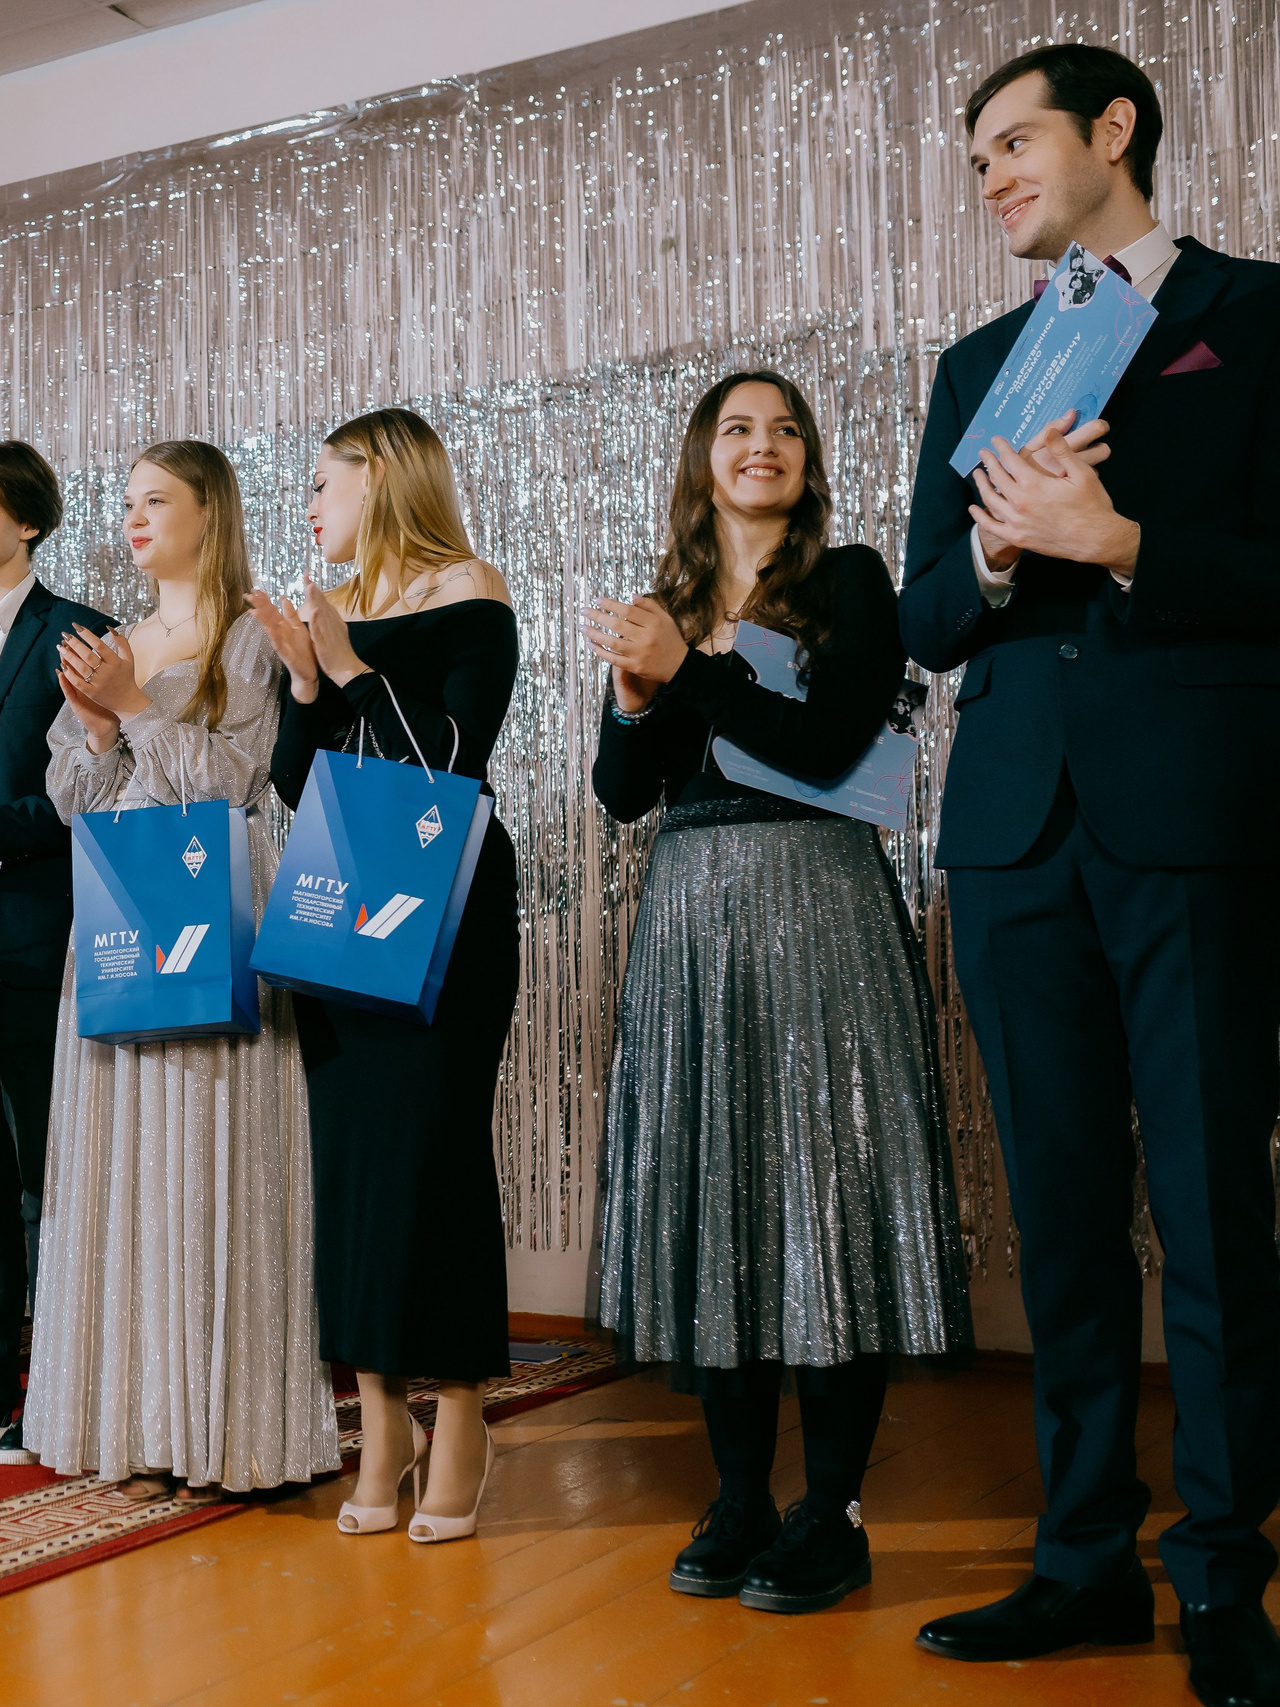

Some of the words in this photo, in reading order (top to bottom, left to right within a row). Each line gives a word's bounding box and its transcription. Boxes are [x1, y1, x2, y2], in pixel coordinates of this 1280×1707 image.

[994, 315, 1056, 418] БЛАГОДАРСТВЕННОЕ
[1014, 349, 1042, 394] ПИСЬМО
[1011, 406, 1036, 445] ГЛЕБУ
[1035, 331, 1082, 406] ИГОРЕВИЧУ
[1021, 350, 1062, 417] ЧИКУНОВУ
[420, 824, 438, 832] МГТУ
[296, 873, 349, 895] МГТУ
[291, 896, 342, 911] ГОСУДАРСТВЕННЫЙ
[292, 890, 344, 905] МАГНИТОГОРСКИЙ
[295, 910, 332, 921] УНИВЕРСИТЕТ
[296, 903, 335, 915] ТЕХНИЧЕСКИЙ
[94, 930, 139, 948] МГТУ
[94, 946, 140, 957] МАГНИТОГОРСКИЙ
[94, 953, 140, 963] ГОСУДАРСТВЕННЫЙ
[100, 959, 135, 968] ТЕХНИЧЕСКИЙ
[101, 966, 134, 974] УНИВЕРСИТЕТ
